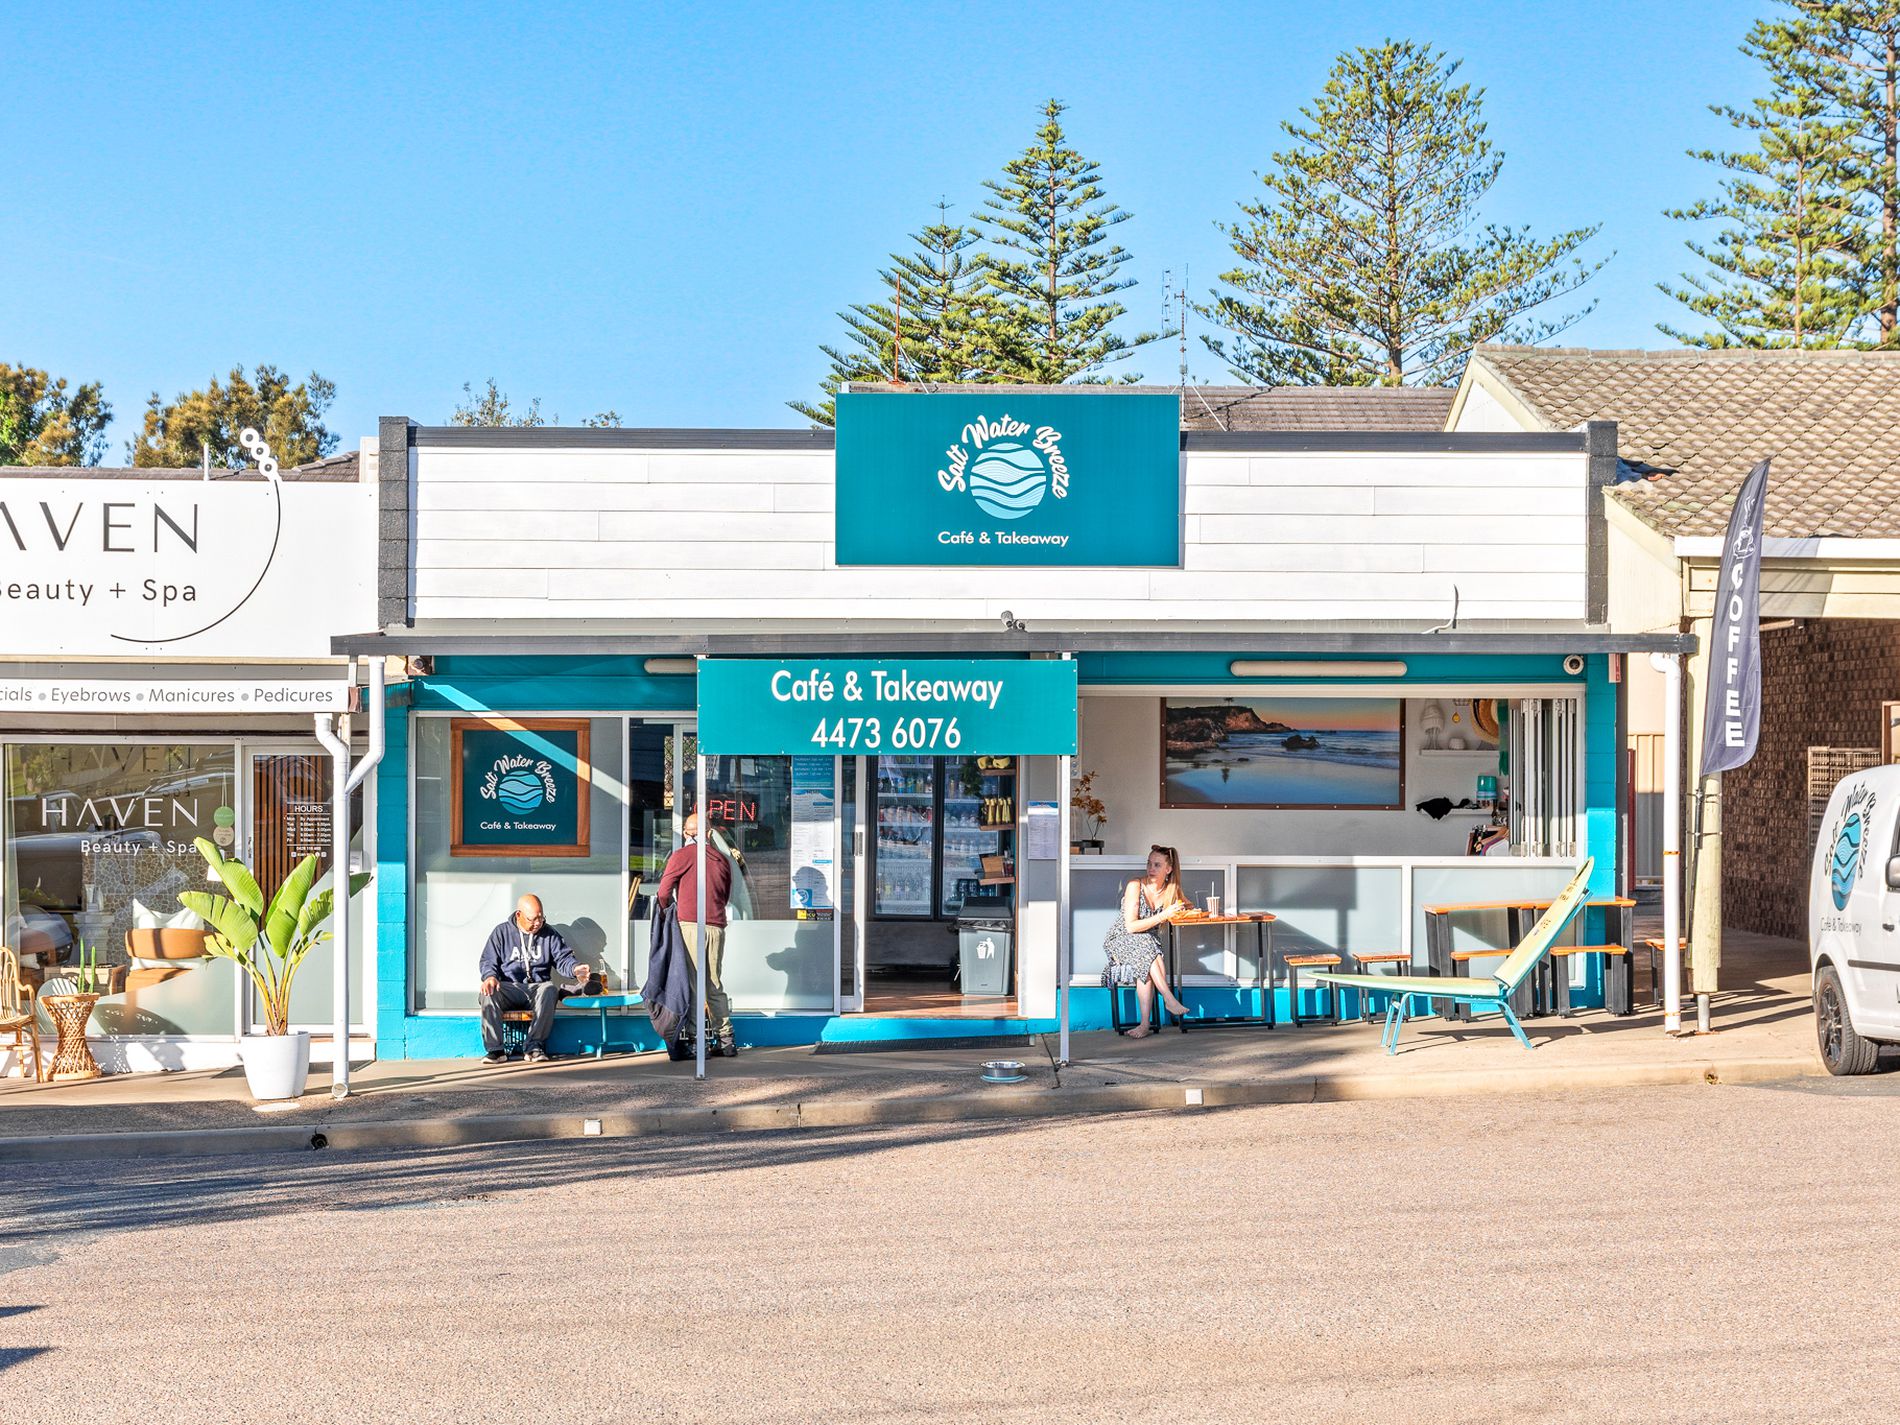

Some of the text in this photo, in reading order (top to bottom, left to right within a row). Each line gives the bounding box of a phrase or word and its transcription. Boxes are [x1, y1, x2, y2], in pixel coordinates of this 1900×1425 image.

[937, 414, 1071, 499] Salt Water Breeze
[937, 530, 1070, 548] Café & Takeaway
[0, 579, 94, 606] eauty
[142, 578, 197, 607] Spa
[1725, 562, 1745, 748] COFFEE
[51, 687, 131, 704] Eyebrows
[148, 687, 235, 703] Manicures
[254, 687, 333, 703] Pedicures
[770, 669, 1004, 710] Café & Takeaway
[810, 717, 962, 749] 4473 6076
[480, 754, 557, 803] Salt Water Breeze
[42, 798, 198, 827] HAVEN
[294, 805, 324, 813] HOURS
[693, 799, 756, 821] PEN
[480, 821, 556, 831] Café & Takeaway
[80, 839, 141, 856] Beauty
[166, 840, 198, 857] Spa
